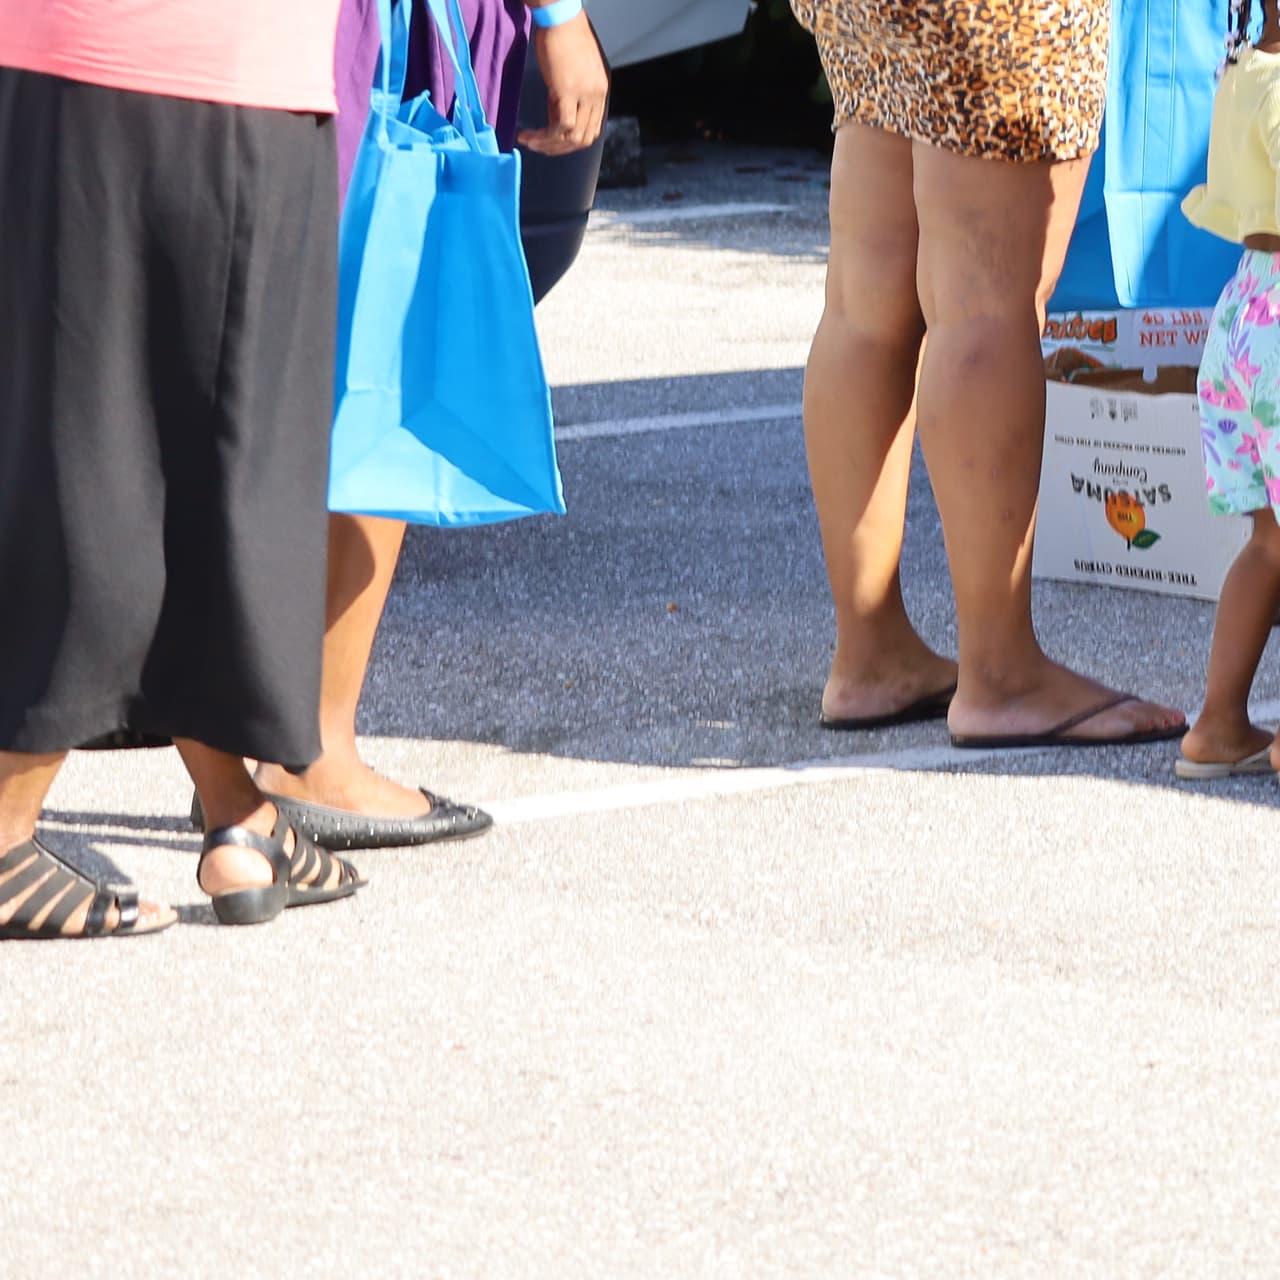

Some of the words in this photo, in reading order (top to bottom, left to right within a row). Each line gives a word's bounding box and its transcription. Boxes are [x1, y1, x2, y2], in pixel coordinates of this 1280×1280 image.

[1139, 330, 1177, 347] NET
[1093, 458, 1148, 483] Company
[1070, 473, 1172, 508] SATSUMA
[1073, 559, 1113, 578] CITRUS
